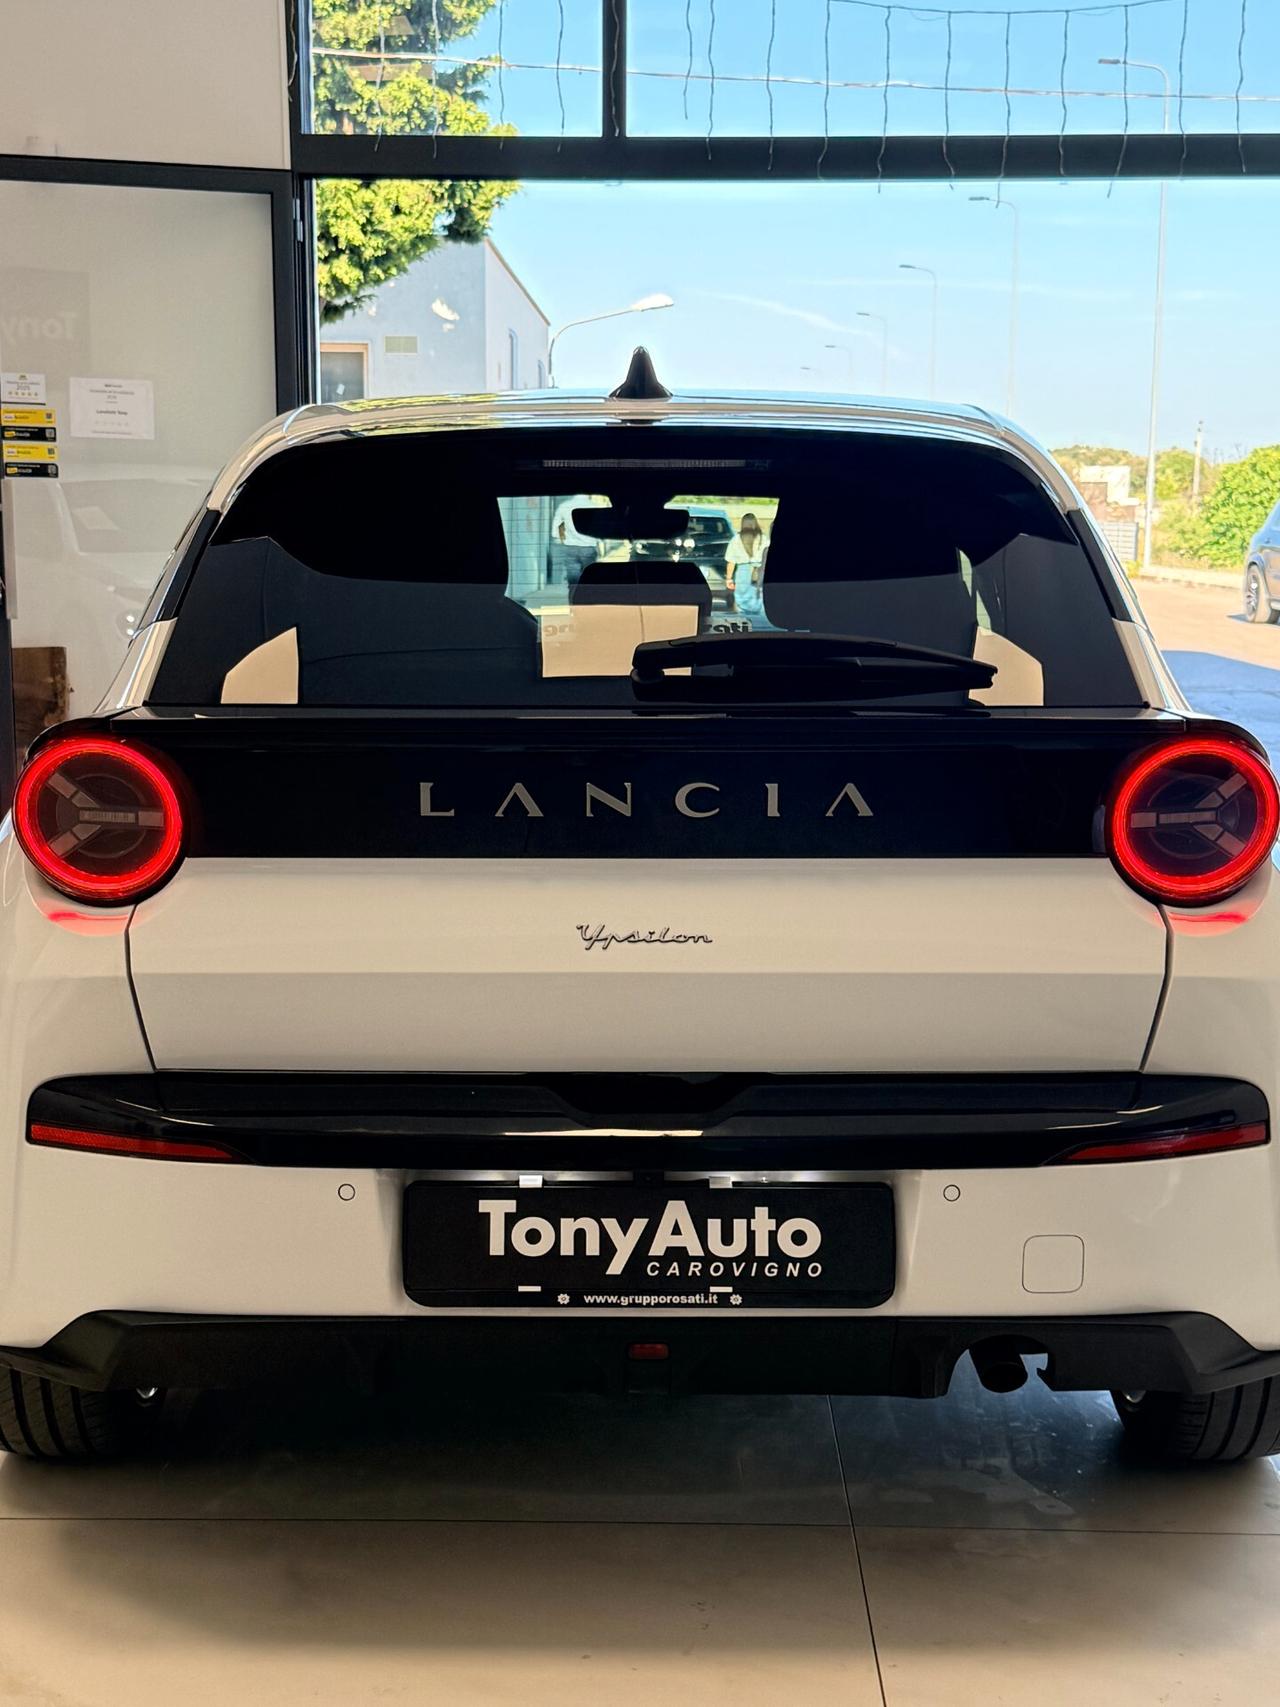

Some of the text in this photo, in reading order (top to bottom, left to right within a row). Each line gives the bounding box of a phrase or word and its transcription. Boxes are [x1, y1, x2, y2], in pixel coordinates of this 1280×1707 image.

[419, 781, 874, 818] LANCIA
[576, 923, 713, 951] Ypsilon
[646, 1261, 823, 1278] CAROVIGNO
[583, 1292, 719, 1306] www.grupporosati.it
